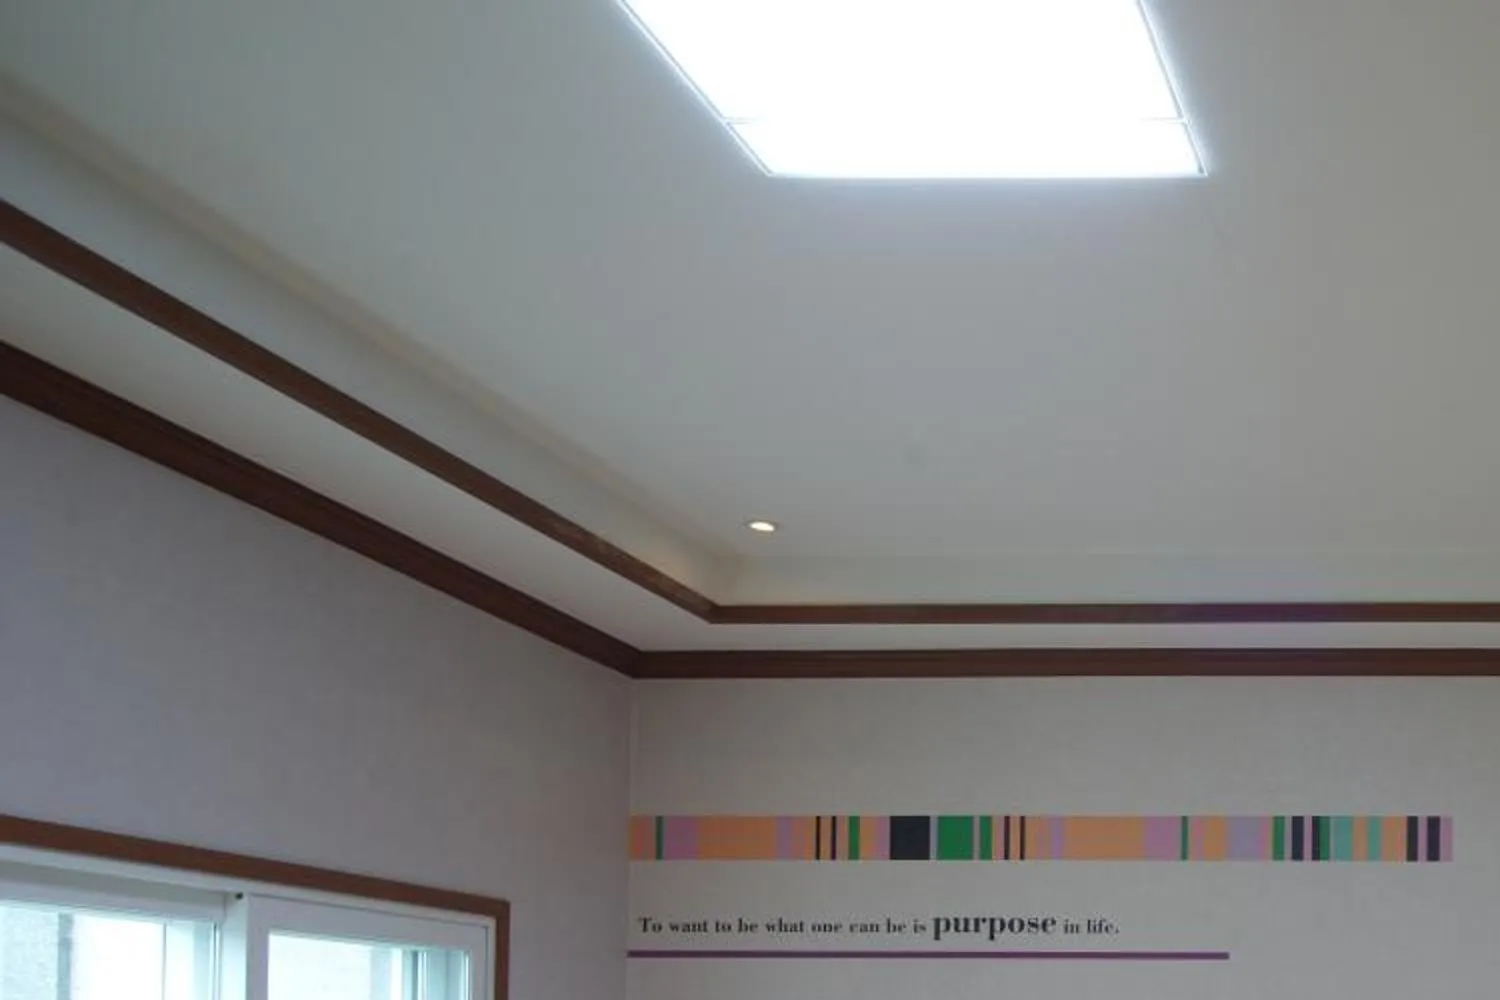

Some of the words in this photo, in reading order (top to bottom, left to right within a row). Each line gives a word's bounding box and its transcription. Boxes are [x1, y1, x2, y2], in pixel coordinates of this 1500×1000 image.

[638, 917, 663, 933] To
[669, 919, 709, 933] want
[715, 919, 732, 933] to
[737, 917, 759, 933] be
[765, 917, 805, 933] what
[811, 921, 843, 933] one
[849, 921, 881, 933] can
[886, 918, 907, 934] be
[913, 919, 927, 934] is
[933, 916, 1057, 940] purpose
[1064, 919, 1080, 934] in
[1087, 918, 1119, 934] life.
